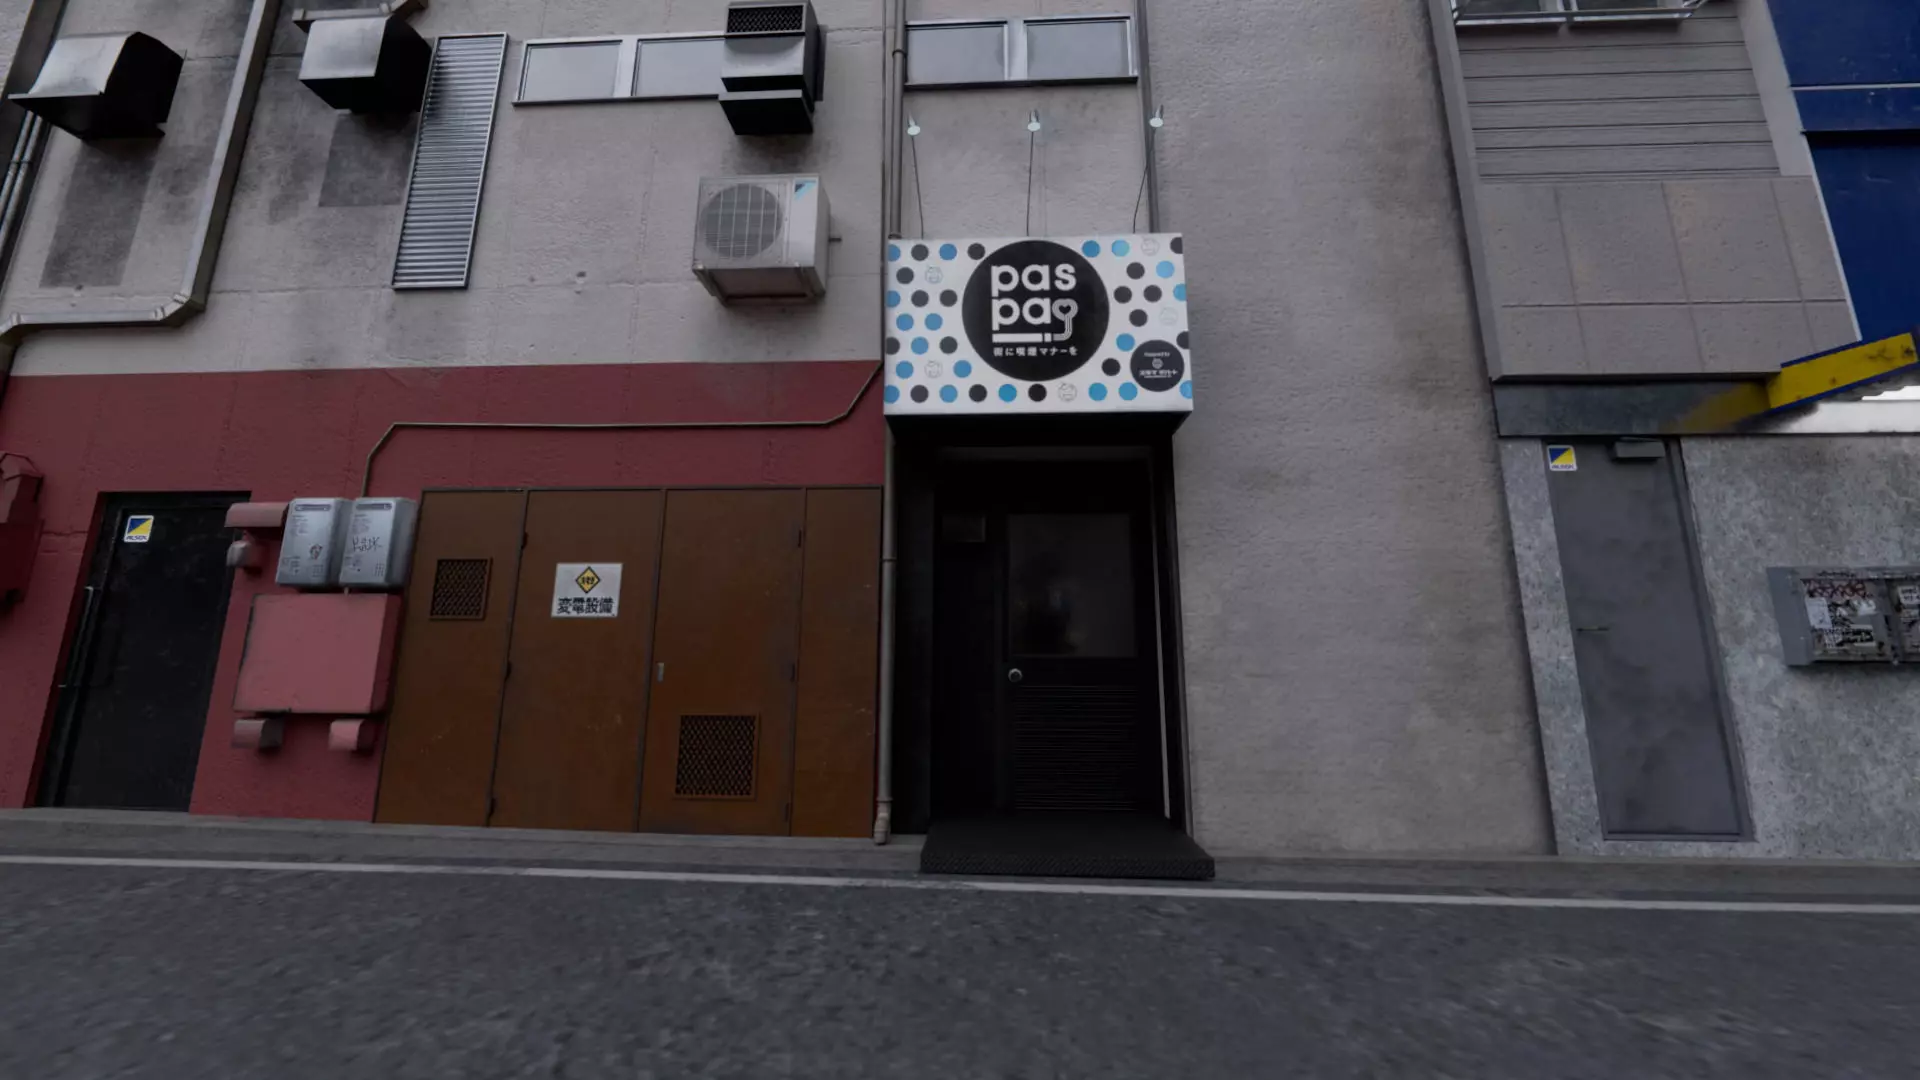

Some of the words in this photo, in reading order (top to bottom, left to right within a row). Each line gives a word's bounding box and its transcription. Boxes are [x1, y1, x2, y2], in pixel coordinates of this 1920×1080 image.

[991, 263, 1077, 297] pas
[557, 597, 614, 614] 変電設備
